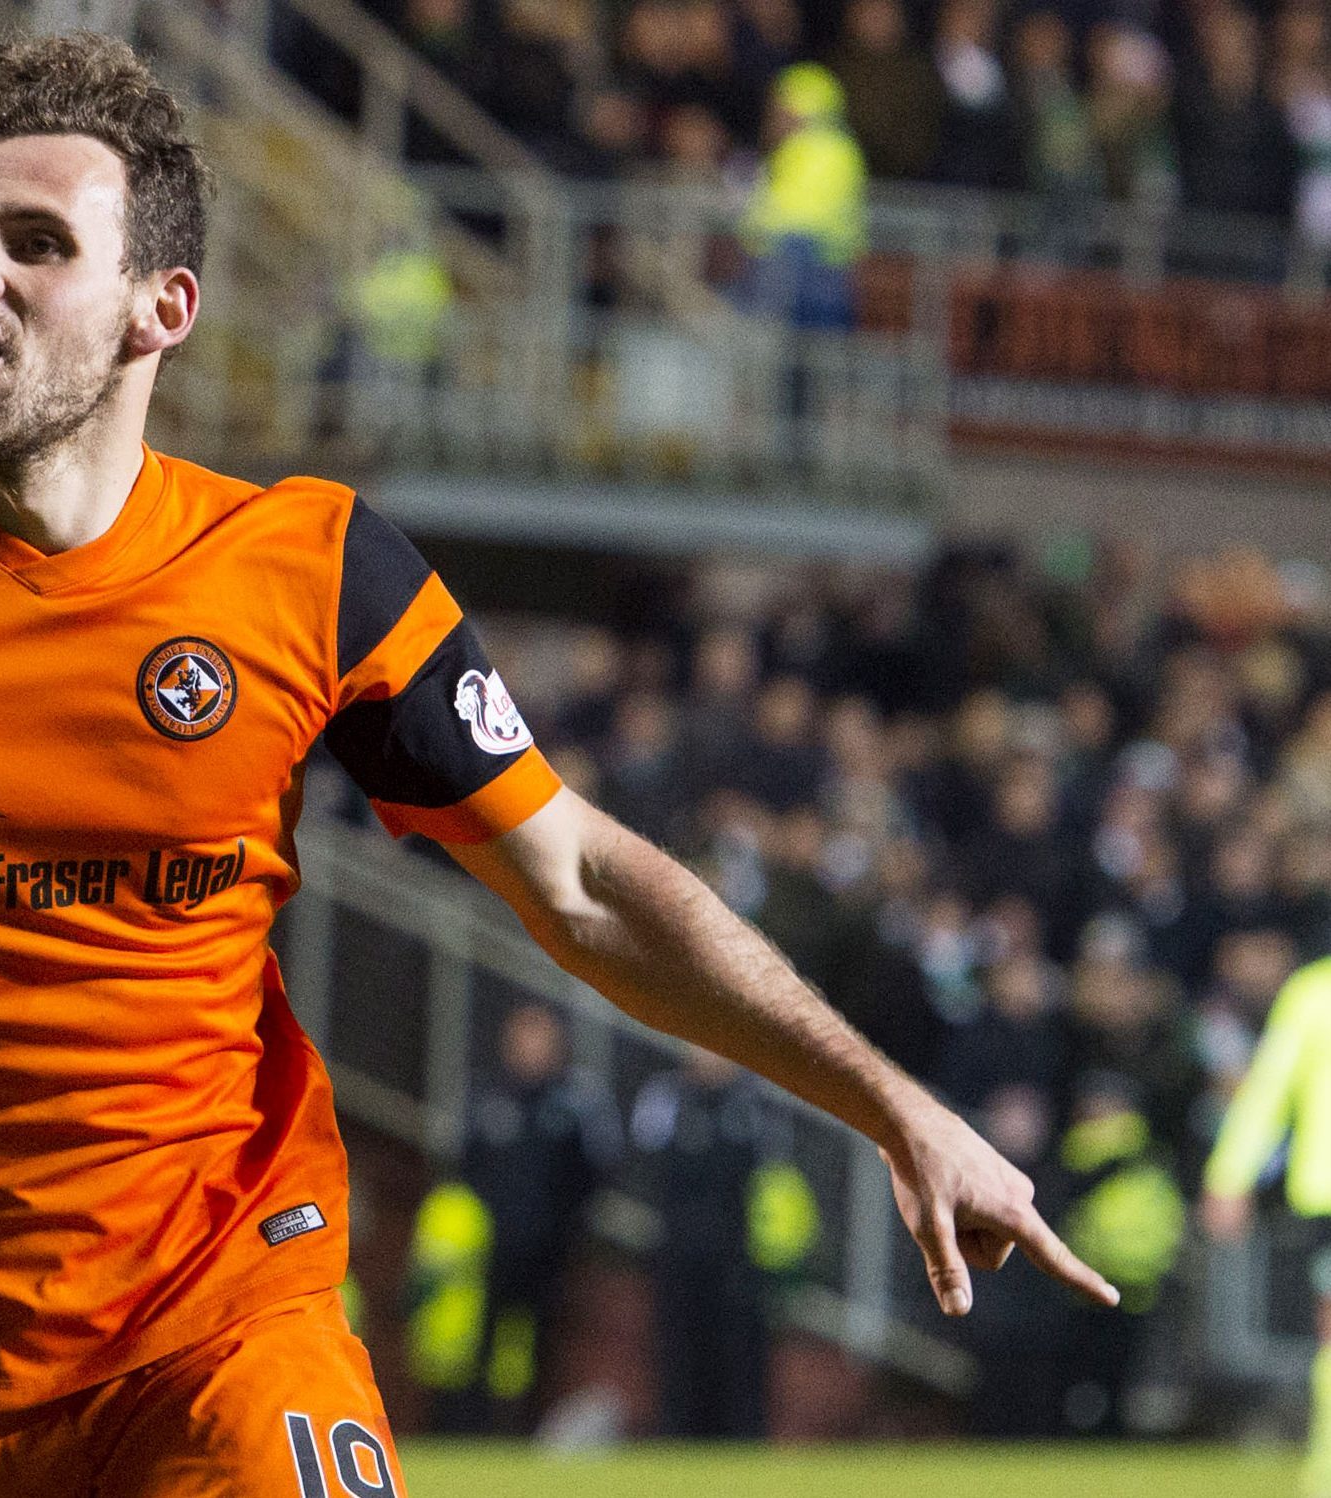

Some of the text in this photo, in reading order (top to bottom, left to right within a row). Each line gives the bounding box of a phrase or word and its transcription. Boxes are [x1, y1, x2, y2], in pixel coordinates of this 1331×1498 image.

[149, 644, 227, 676] DUNDEE UNITED
[148, 697, 197, 733] FOOTBALL
[143, 837, 246, 911] Legal
[284, 1411, 399, 1498] 19
